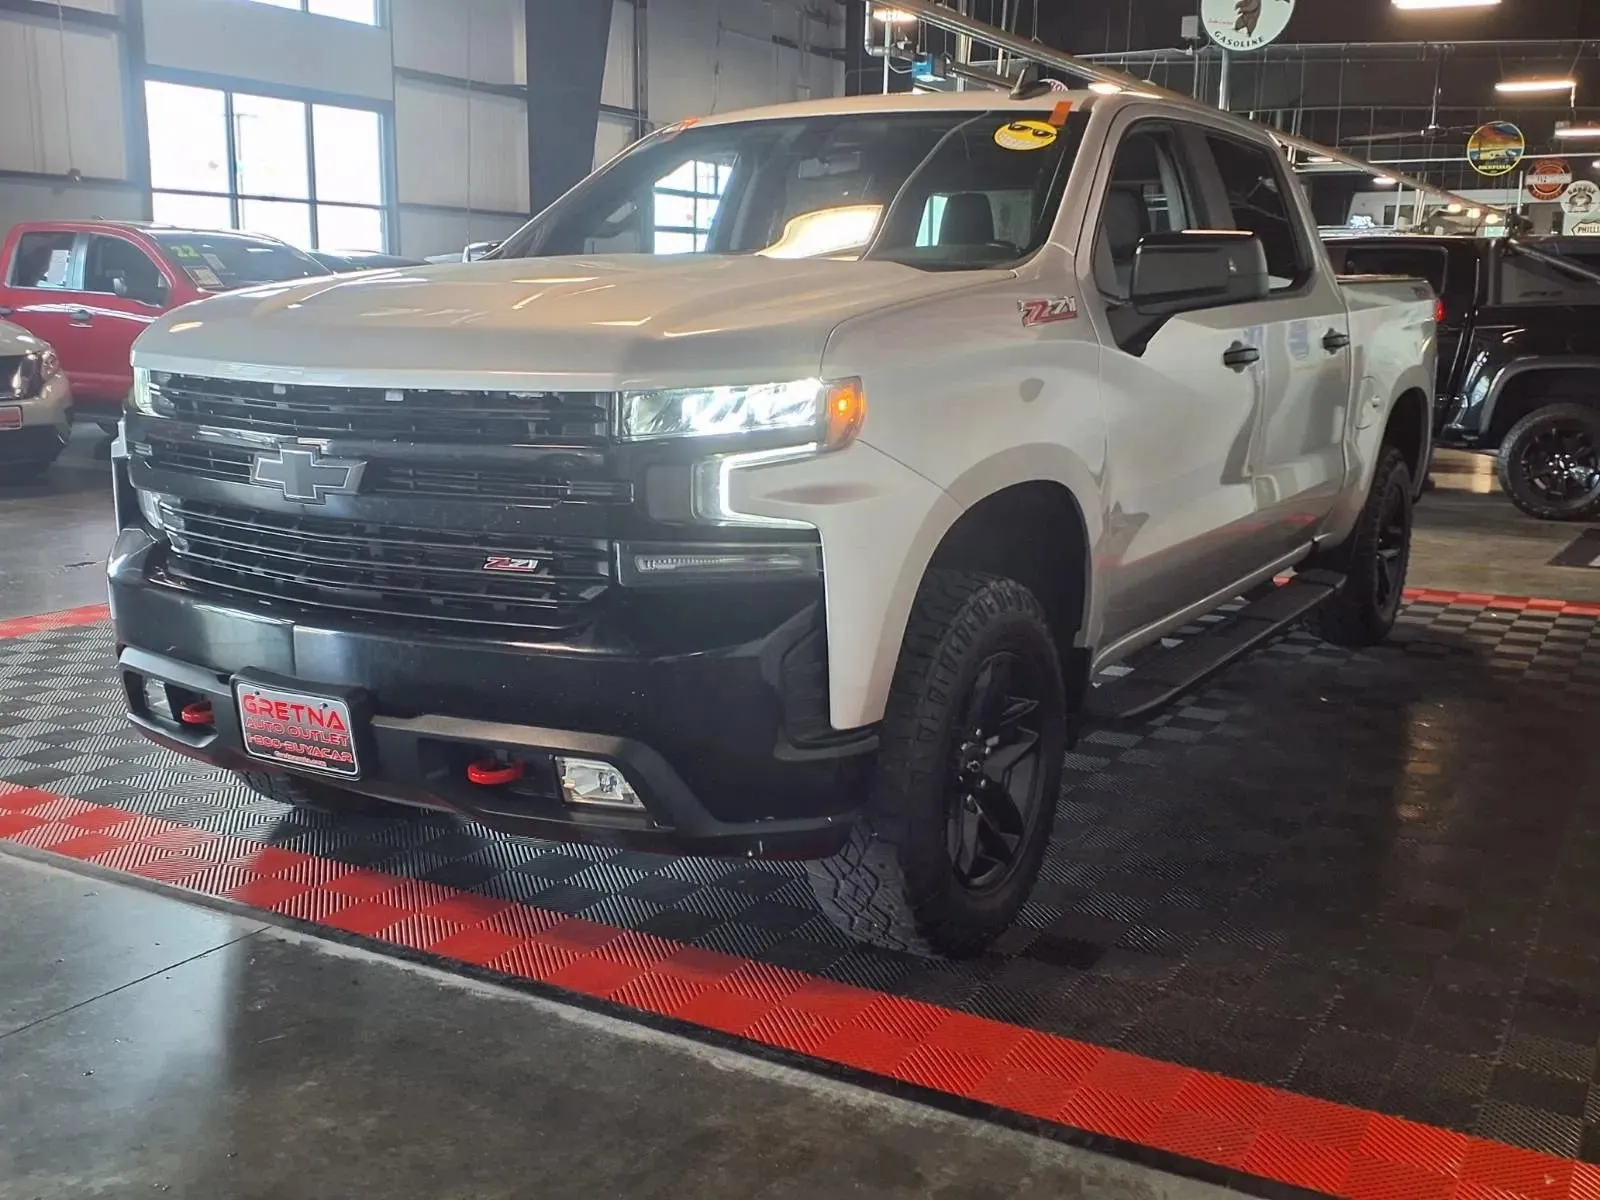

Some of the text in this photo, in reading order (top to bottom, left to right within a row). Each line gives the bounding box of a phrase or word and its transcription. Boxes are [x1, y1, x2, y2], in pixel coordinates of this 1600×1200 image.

[1214, 30, 1265, 48] GASOLINE
[1019, 296, 1078, 327] Z71
[483, 556, 539, 572] Z71
[243, 694, 346, 731] GRETNA
[246, 717, 350, 747] AUTO OUTLET
